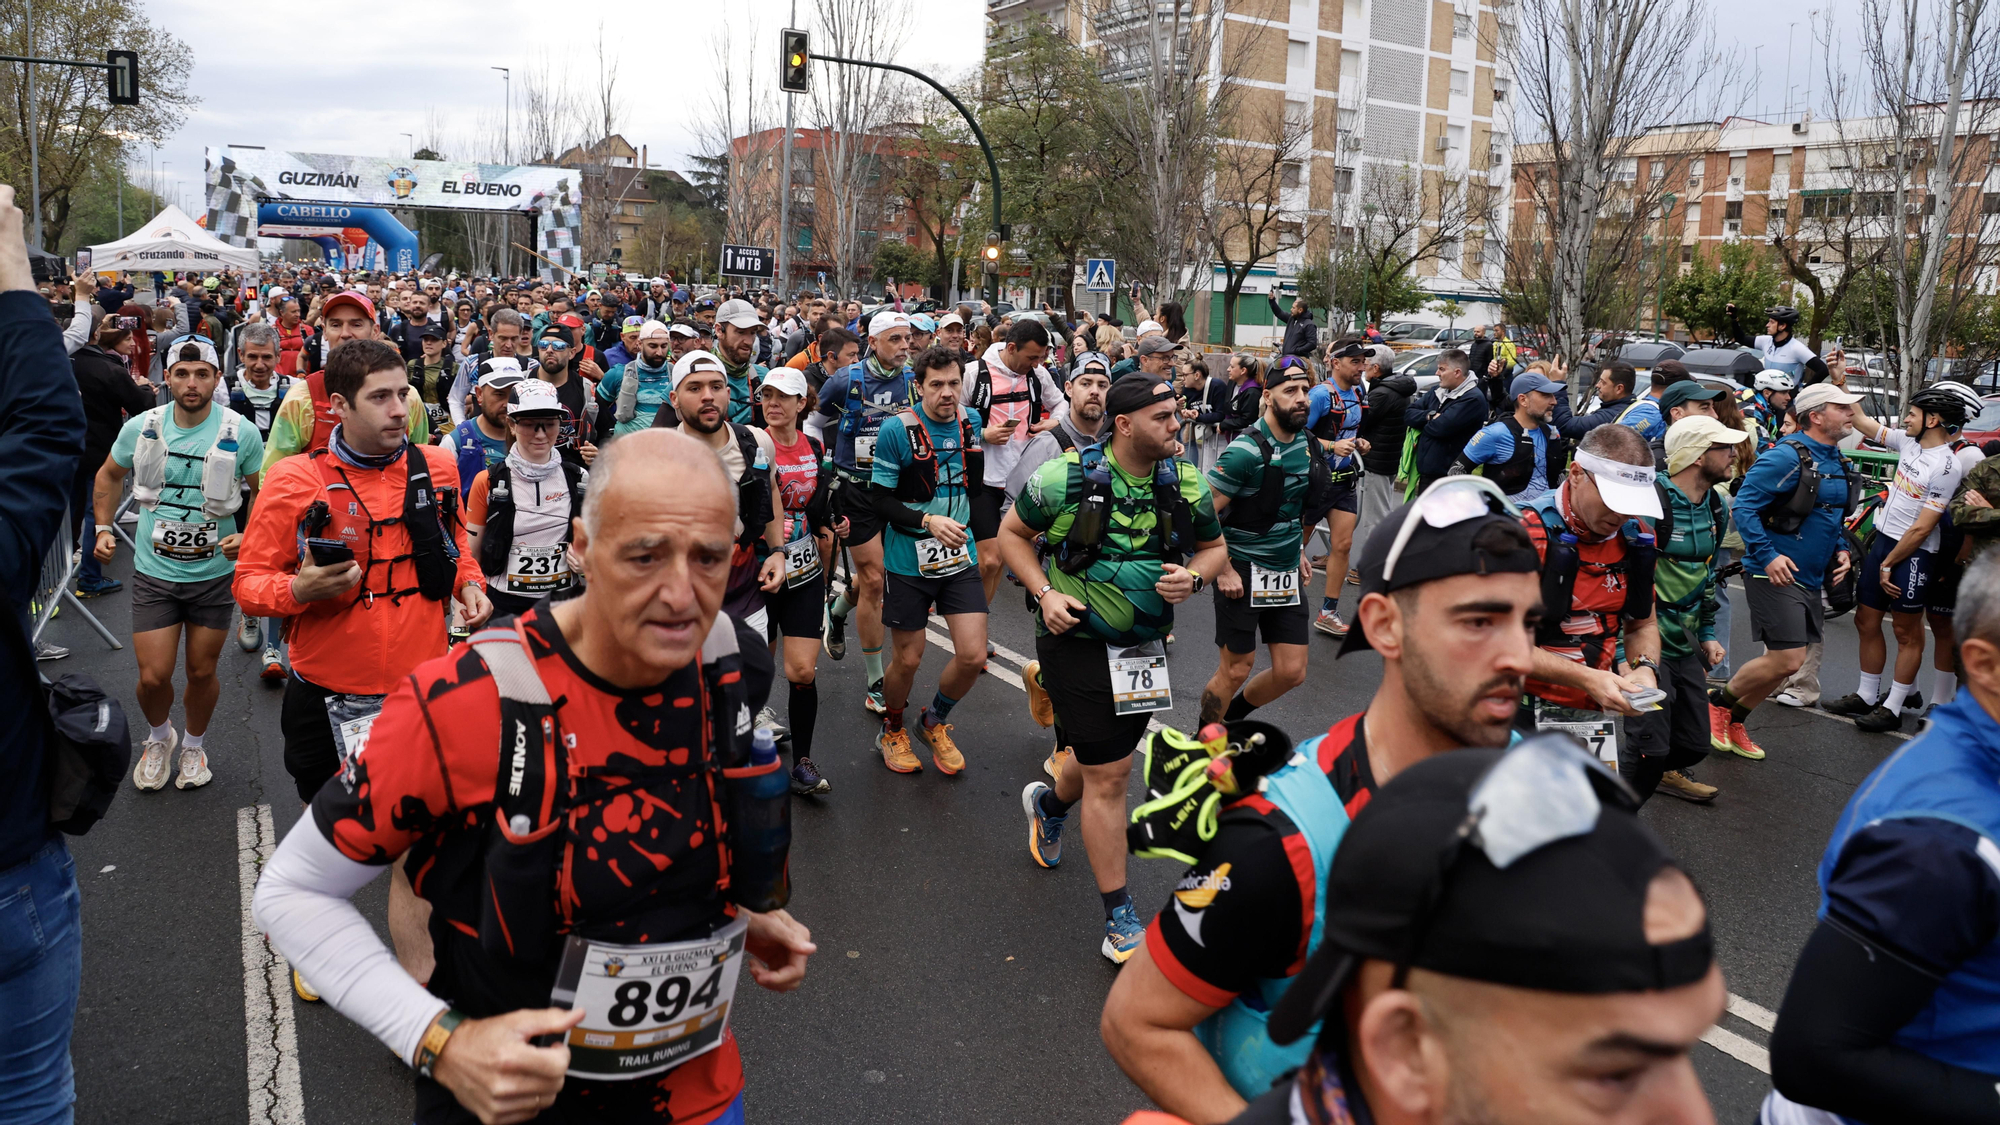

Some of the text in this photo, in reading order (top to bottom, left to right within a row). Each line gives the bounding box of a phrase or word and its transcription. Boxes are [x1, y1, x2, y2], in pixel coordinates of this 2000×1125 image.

[279, 171, 359, 188] GUZMÁN
[441, 180, 522, 197] EL BUENO
[277, 205, 351, 219] CABELLO
[738, 248, 760, 257] ACCESO
[736, 256, 761, 272] MTB
[163, 530, 208, 547] 626
[517, 553, 562, 575] 237
[1260, 574, 1292, 590] 110
[1906, 557, 1920, 599] ORBEA
[1127, 669, 1154, 690] 78
[508, 718, 527, 797] AONIJE
[1169, 797, 1198, 831] LEKI
[659, 953, 672, 963] LA
[651, 961, 698, 976] EL BUENO
[607, 964, 724, 1028] 894
[618, 1040, 691, 1067] TRAIL RUNING
